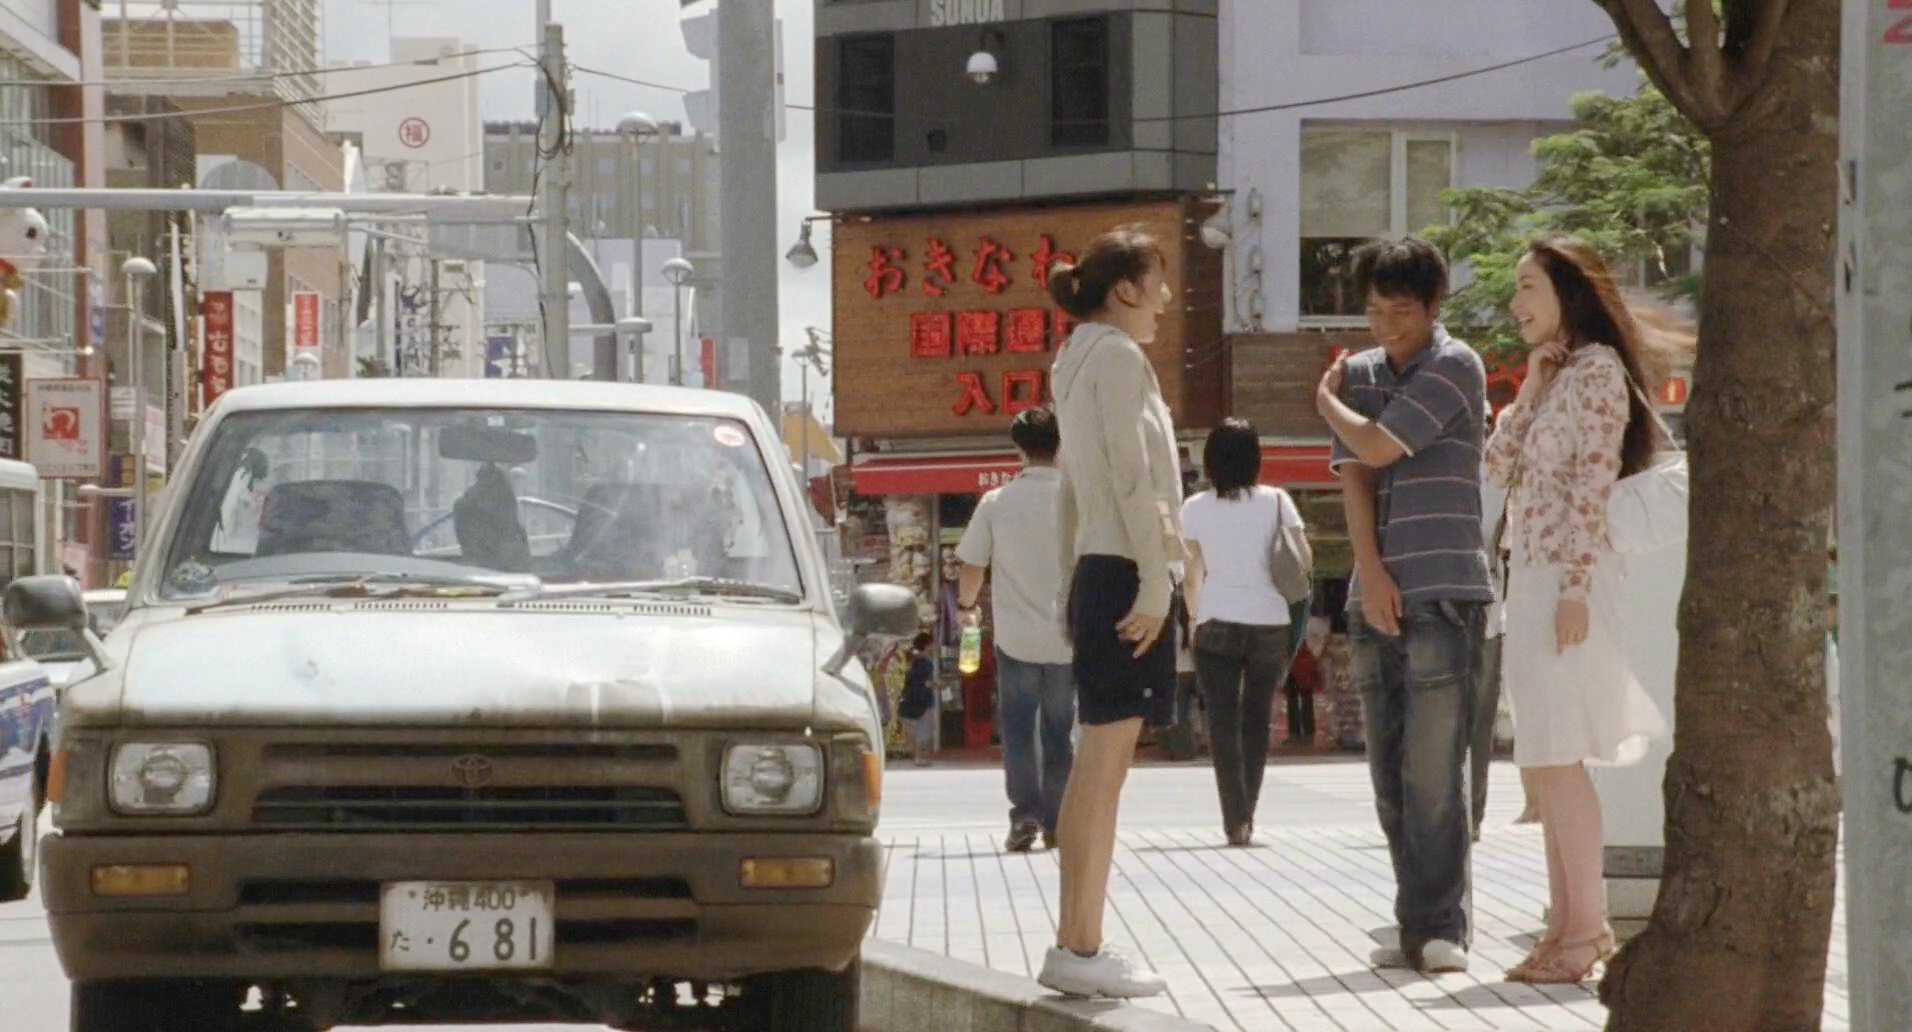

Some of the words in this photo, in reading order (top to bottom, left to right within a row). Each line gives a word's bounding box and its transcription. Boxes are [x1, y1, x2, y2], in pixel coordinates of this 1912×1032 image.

[864, 233, 1075, 299] おきなわ
[422, 888, 516, 911] 沖縄400
